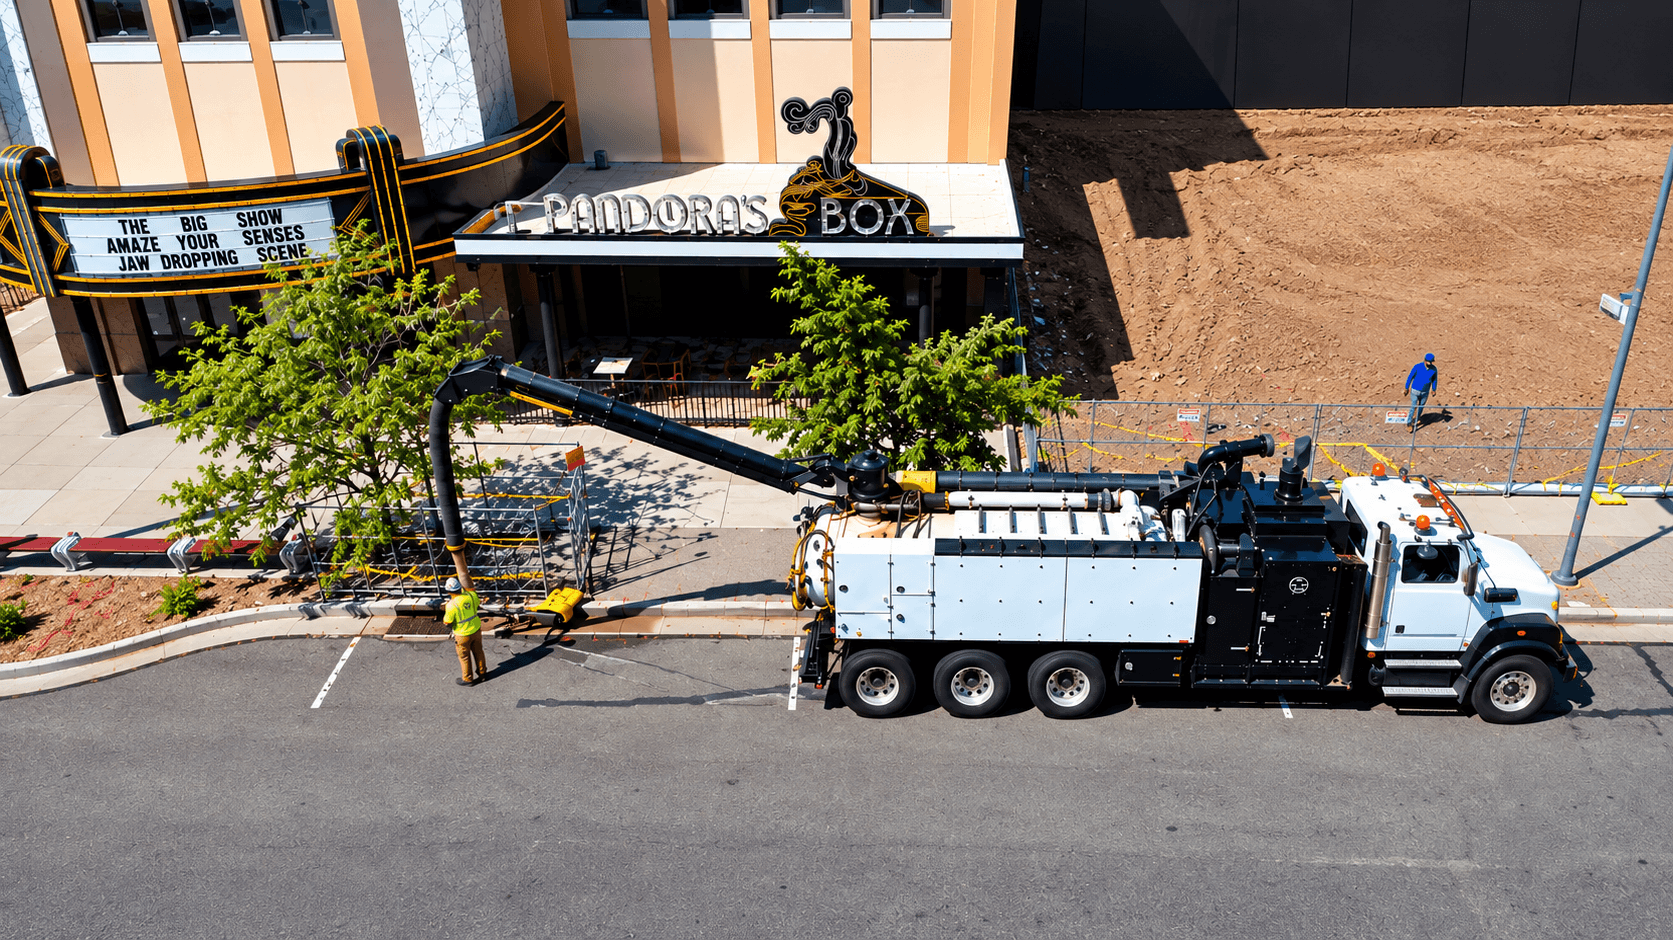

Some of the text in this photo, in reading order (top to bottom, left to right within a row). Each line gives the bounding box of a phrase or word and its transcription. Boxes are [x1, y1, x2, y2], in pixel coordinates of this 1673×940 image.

[118, 208, 282, 235] THE BIG SHOW
[543, 193, 914, 235] PANDORA'S BOX
[106, 225, 305, 254] AMAZE YOUR SENSES
[118, 243, 309, 272] JAW DROPPING SCENE
